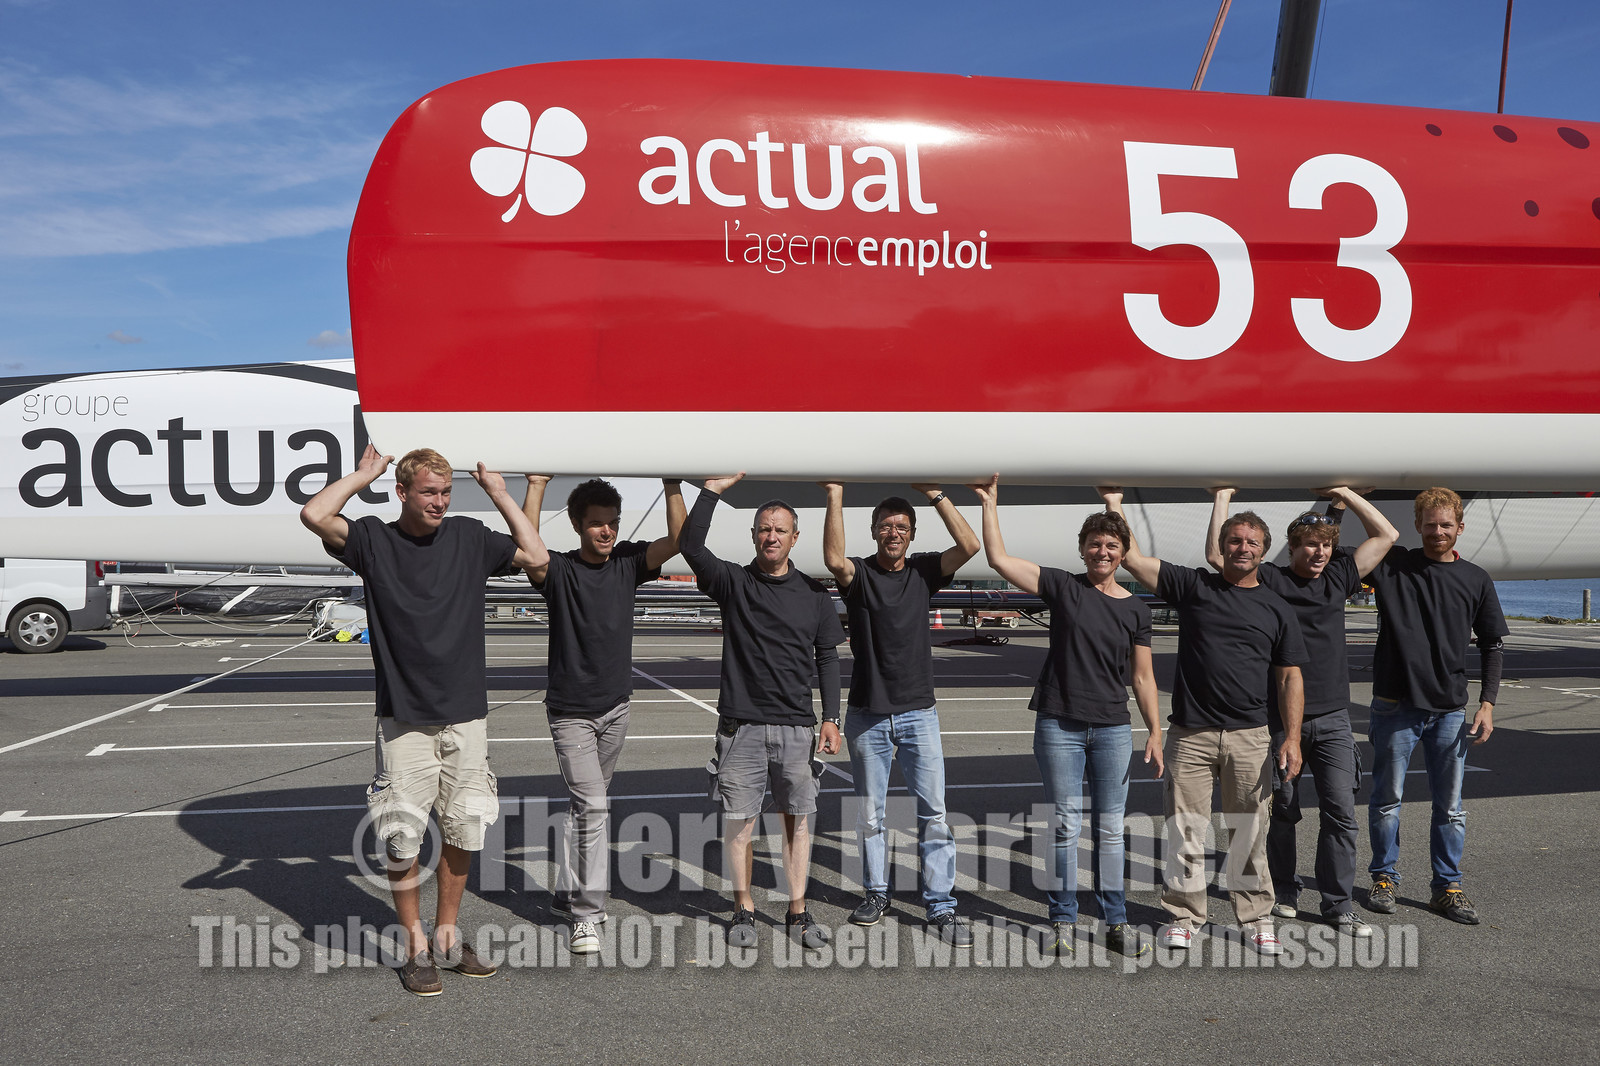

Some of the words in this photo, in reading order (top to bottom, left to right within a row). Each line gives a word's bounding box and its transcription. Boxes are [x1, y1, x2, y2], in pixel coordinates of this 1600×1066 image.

[639, 131, 937, 215] actual
[1123, 141, 1412, 362] 53
[22, 394, 129, 421] groupe
